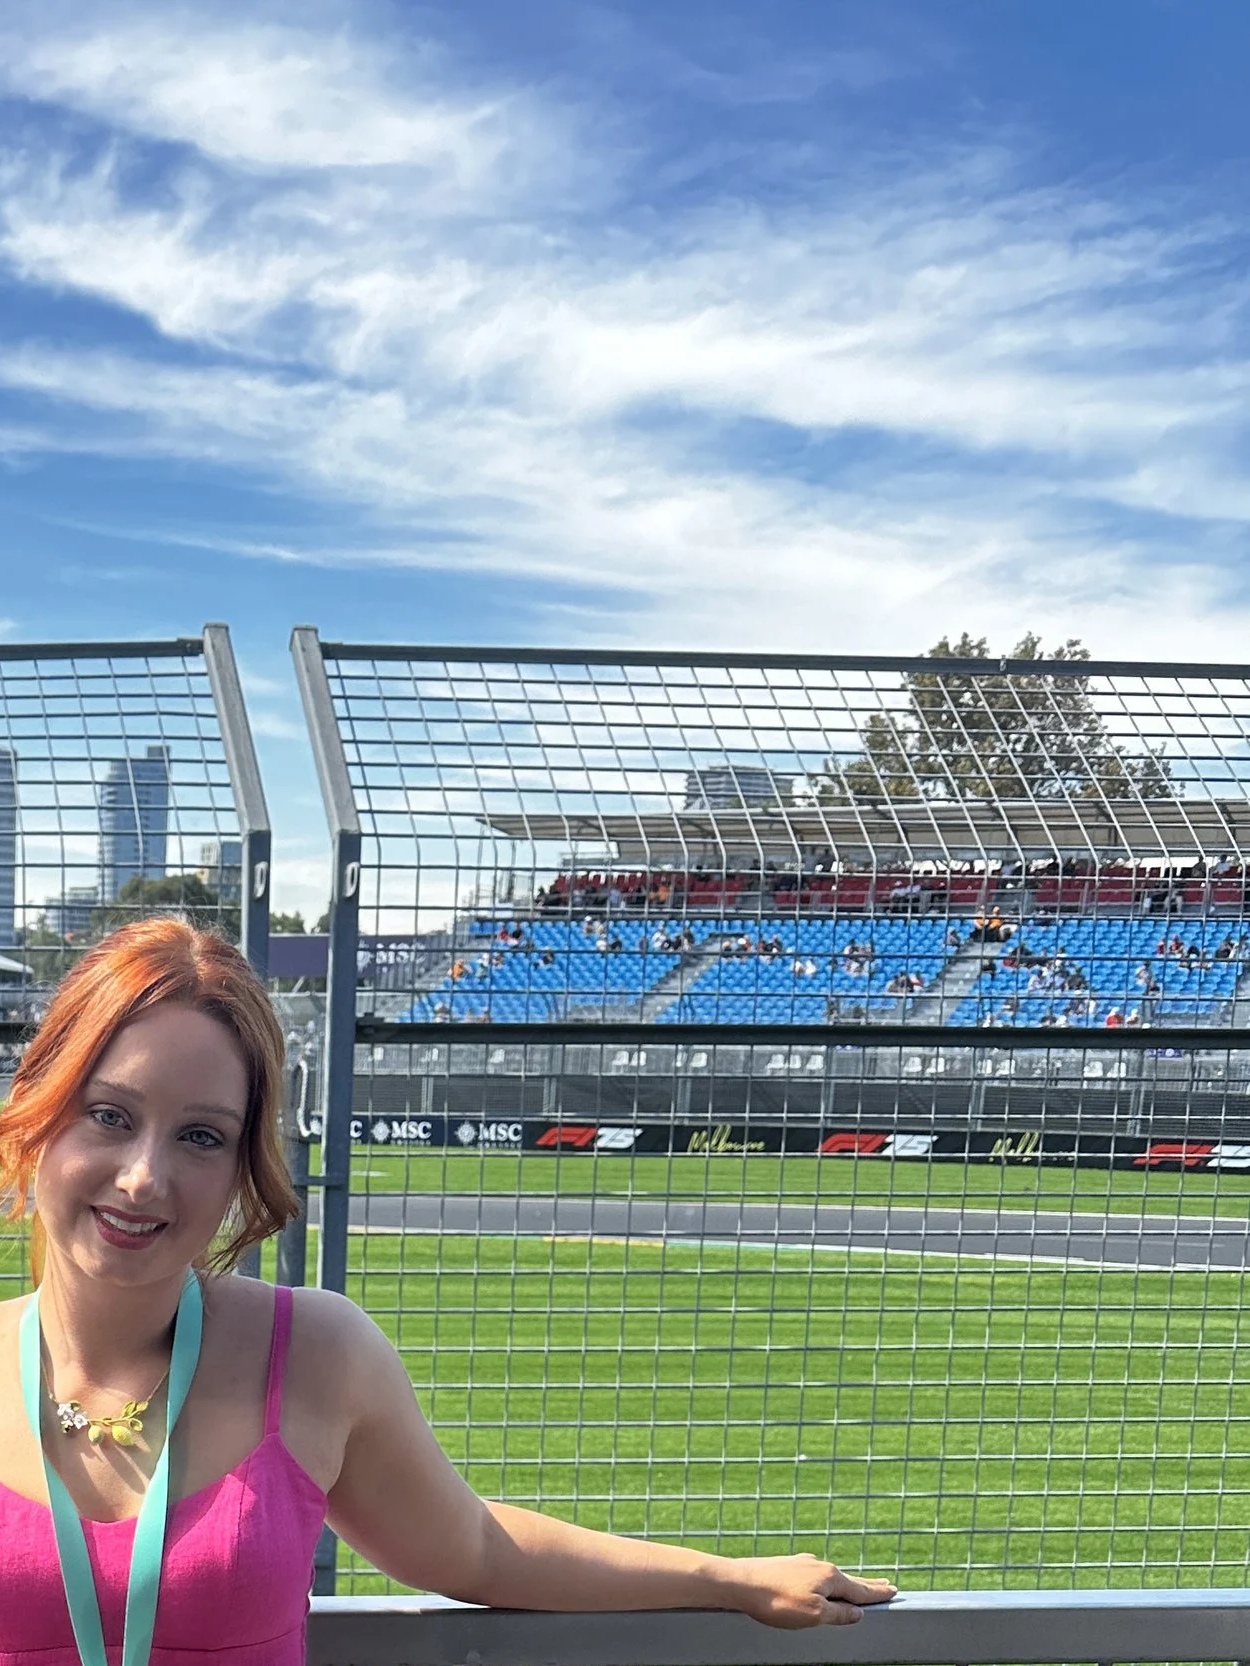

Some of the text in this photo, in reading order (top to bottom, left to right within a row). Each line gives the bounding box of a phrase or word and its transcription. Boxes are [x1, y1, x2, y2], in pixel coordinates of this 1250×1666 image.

[391, 1121, 432, 1139] MSC
[479, 1123, 523, 1141] MSC
[536, 1127, 597, 1146] F1
[688, 1124, 766, 1153] Melbourne
[815, 1133, 888, 1153] F1
